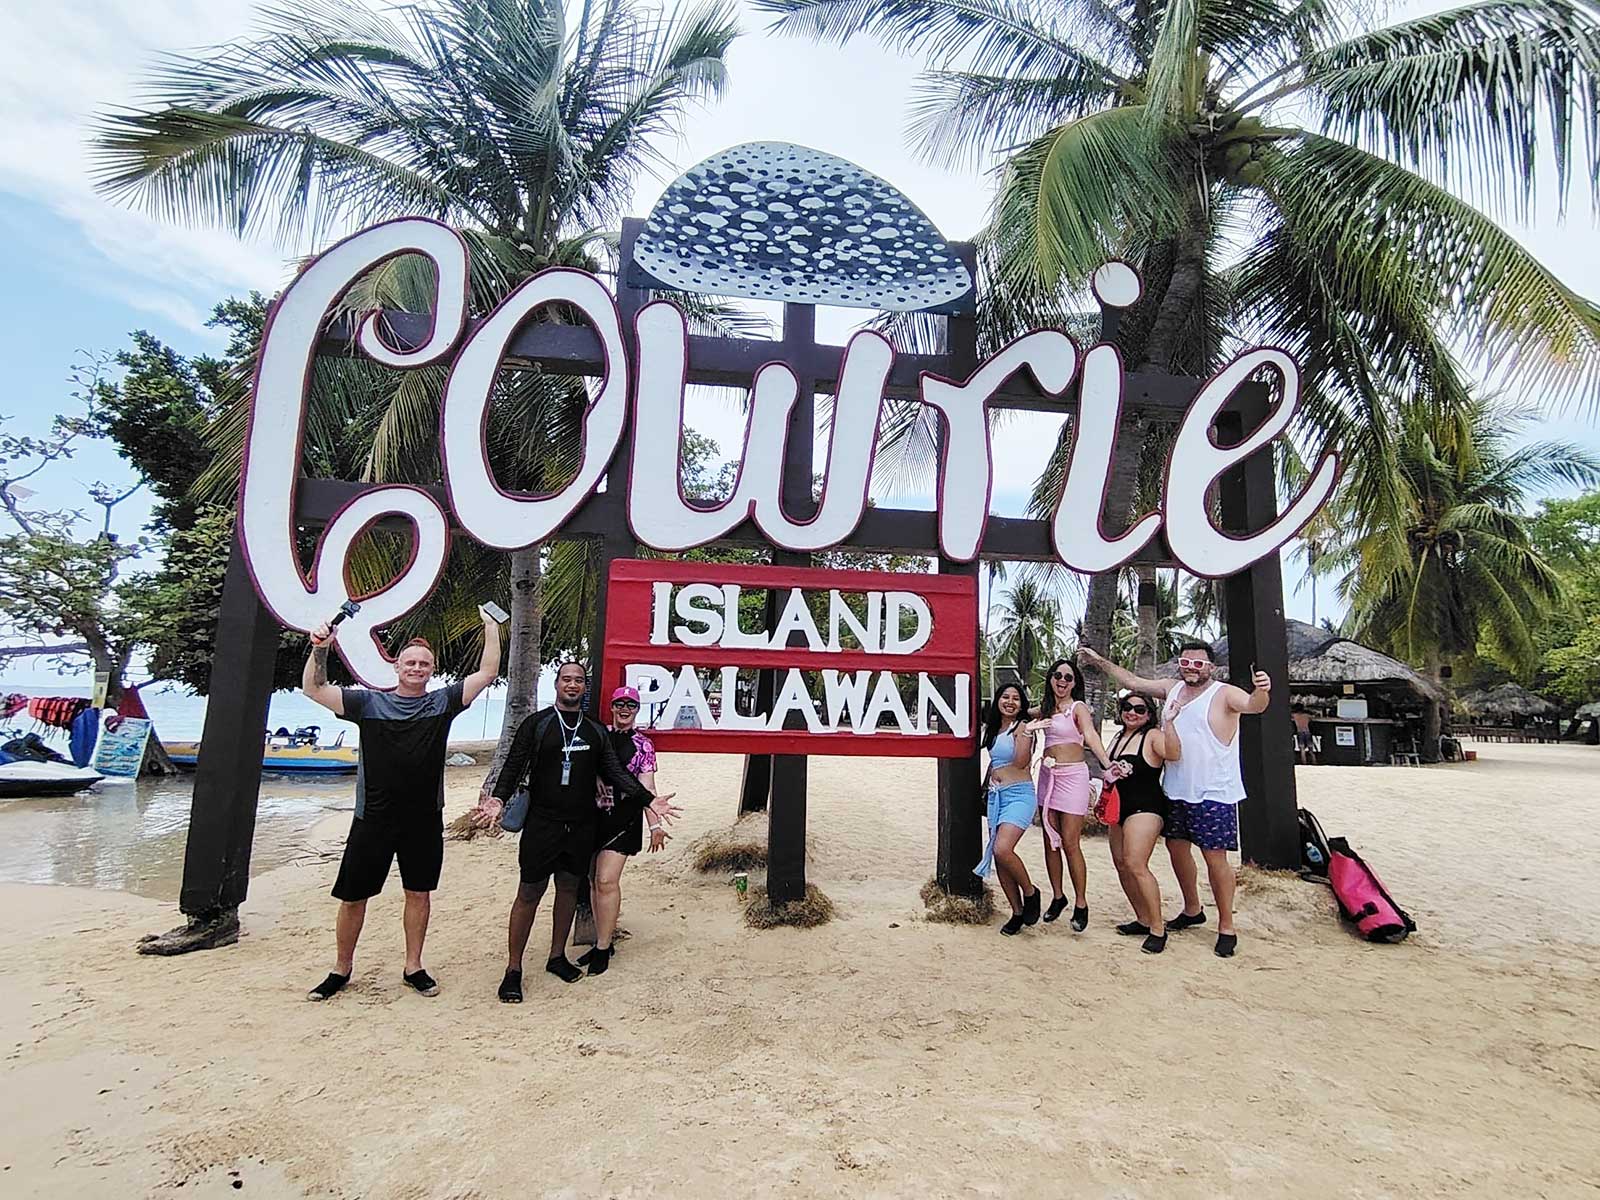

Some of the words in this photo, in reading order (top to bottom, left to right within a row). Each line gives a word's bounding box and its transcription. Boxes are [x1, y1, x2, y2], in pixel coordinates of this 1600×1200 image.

[237, 216, 1340, 691] Cowrie
[650, 581, 934, 654] ISLAND
[624, 664, 971, 738] PALAWAN
